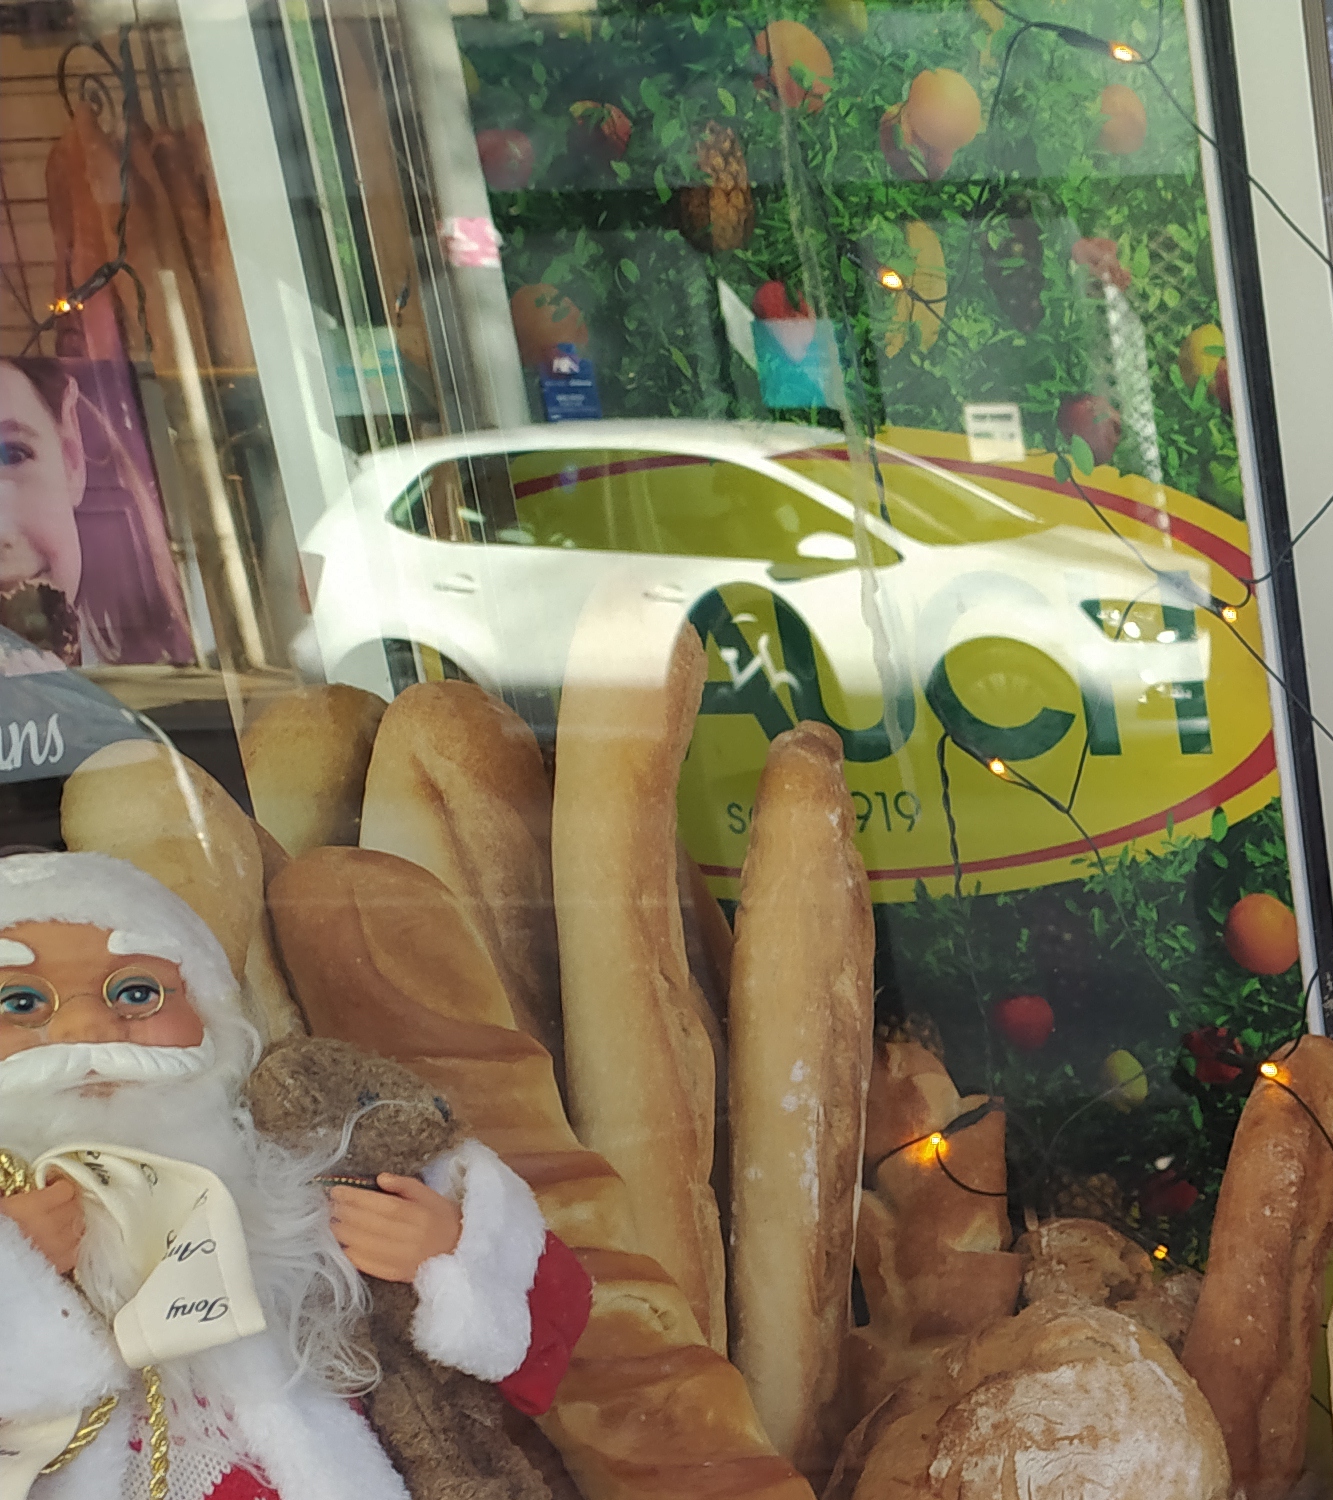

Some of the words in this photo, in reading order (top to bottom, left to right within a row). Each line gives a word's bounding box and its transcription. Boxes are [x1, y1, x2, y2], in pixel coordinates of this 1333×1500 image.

[686, 570, 1214, 764] AUCH
[851, 790, 922, 834] 919
[165, 1297, 229, 1324] Tony
